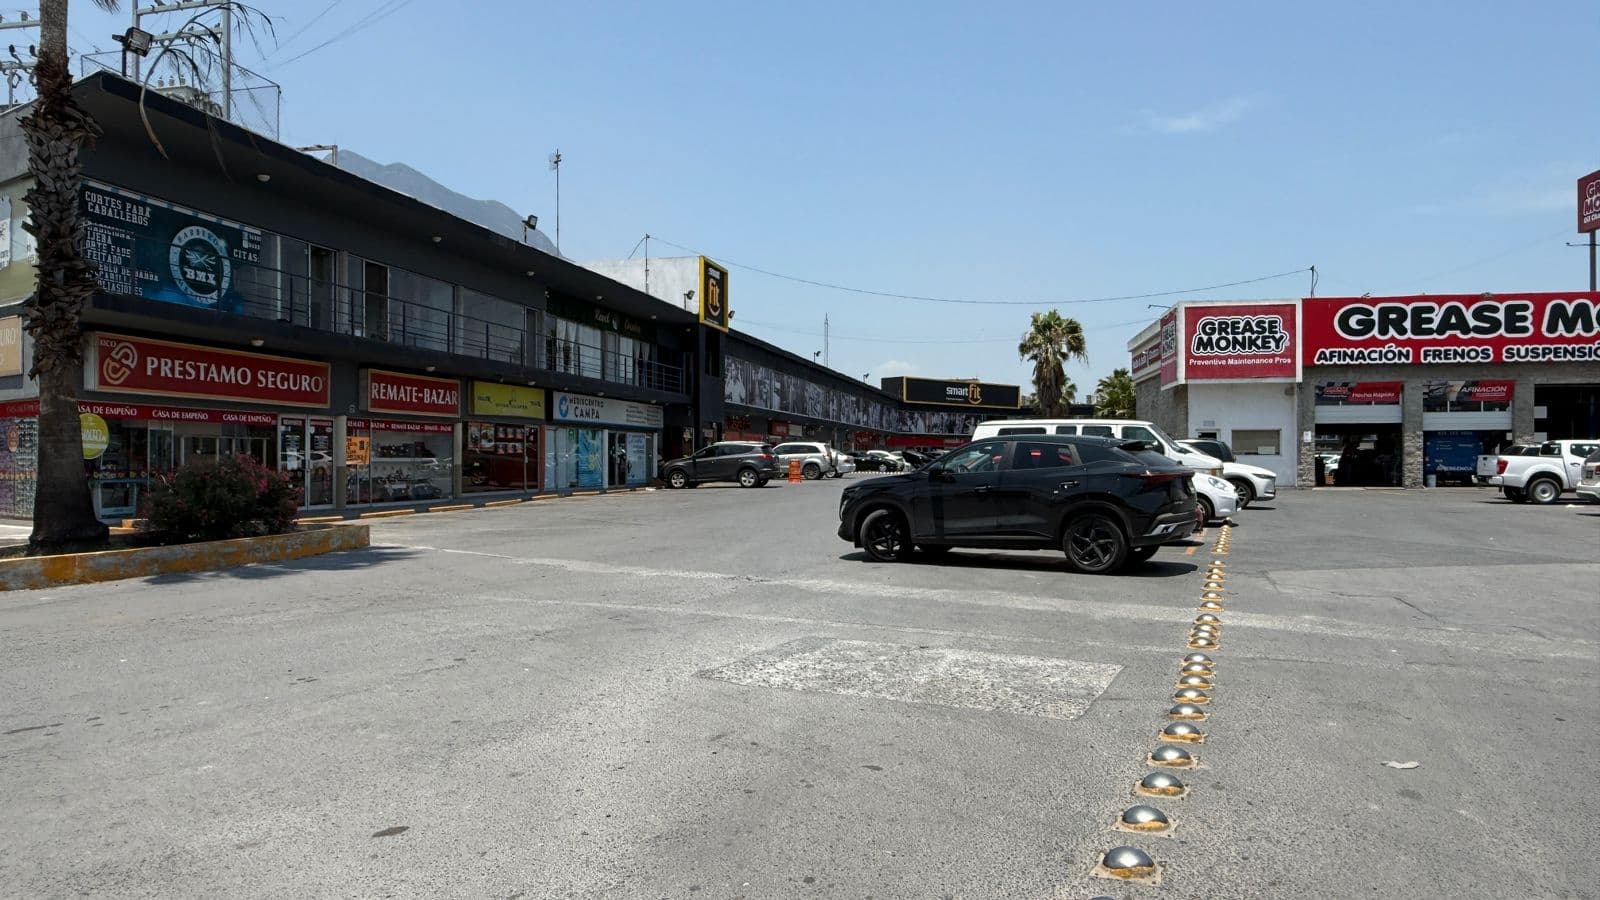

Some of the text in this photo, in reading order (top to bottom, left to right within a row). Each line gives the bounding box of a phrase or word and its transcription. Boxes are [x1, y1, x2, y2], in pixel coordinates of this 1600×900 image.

[85, 191, 152, 218] CORTES PARA
[88, 202, 149, 226] CABALLEROS
[183, 267, 217, 286] BMX
[1200, 319, 1280, 336] GREASE
[1336, 300, 1600, 339] GREASE M
[1194, 334, 1285, 352] MONKEY
[1189, 358, 1227, 366] Preventive
[1228, 356, 1273, 366] Maintenance
[1315, 344, 1412, 364] AFINACIÓN
[1422, 347, 1492, 362] FRENOS
[146, 356, 323, 393] PRESTAMO SEGURO
[371, 382, 458, 405] REMATE-BAZAR
[945, 386, 968, 396] smart
[93, 405, 104, 414] DE
[105, 405, 137, 416] EMPEÑO
[152, 409, 209, 420] CASA DE EMPEÑO
[222, 413, 239, 421] CASA
[240, 414, 248, 422] DE
[248, 414, 272, 423] EMPEÑO
[574, 406, 600, 419] CAMPA
